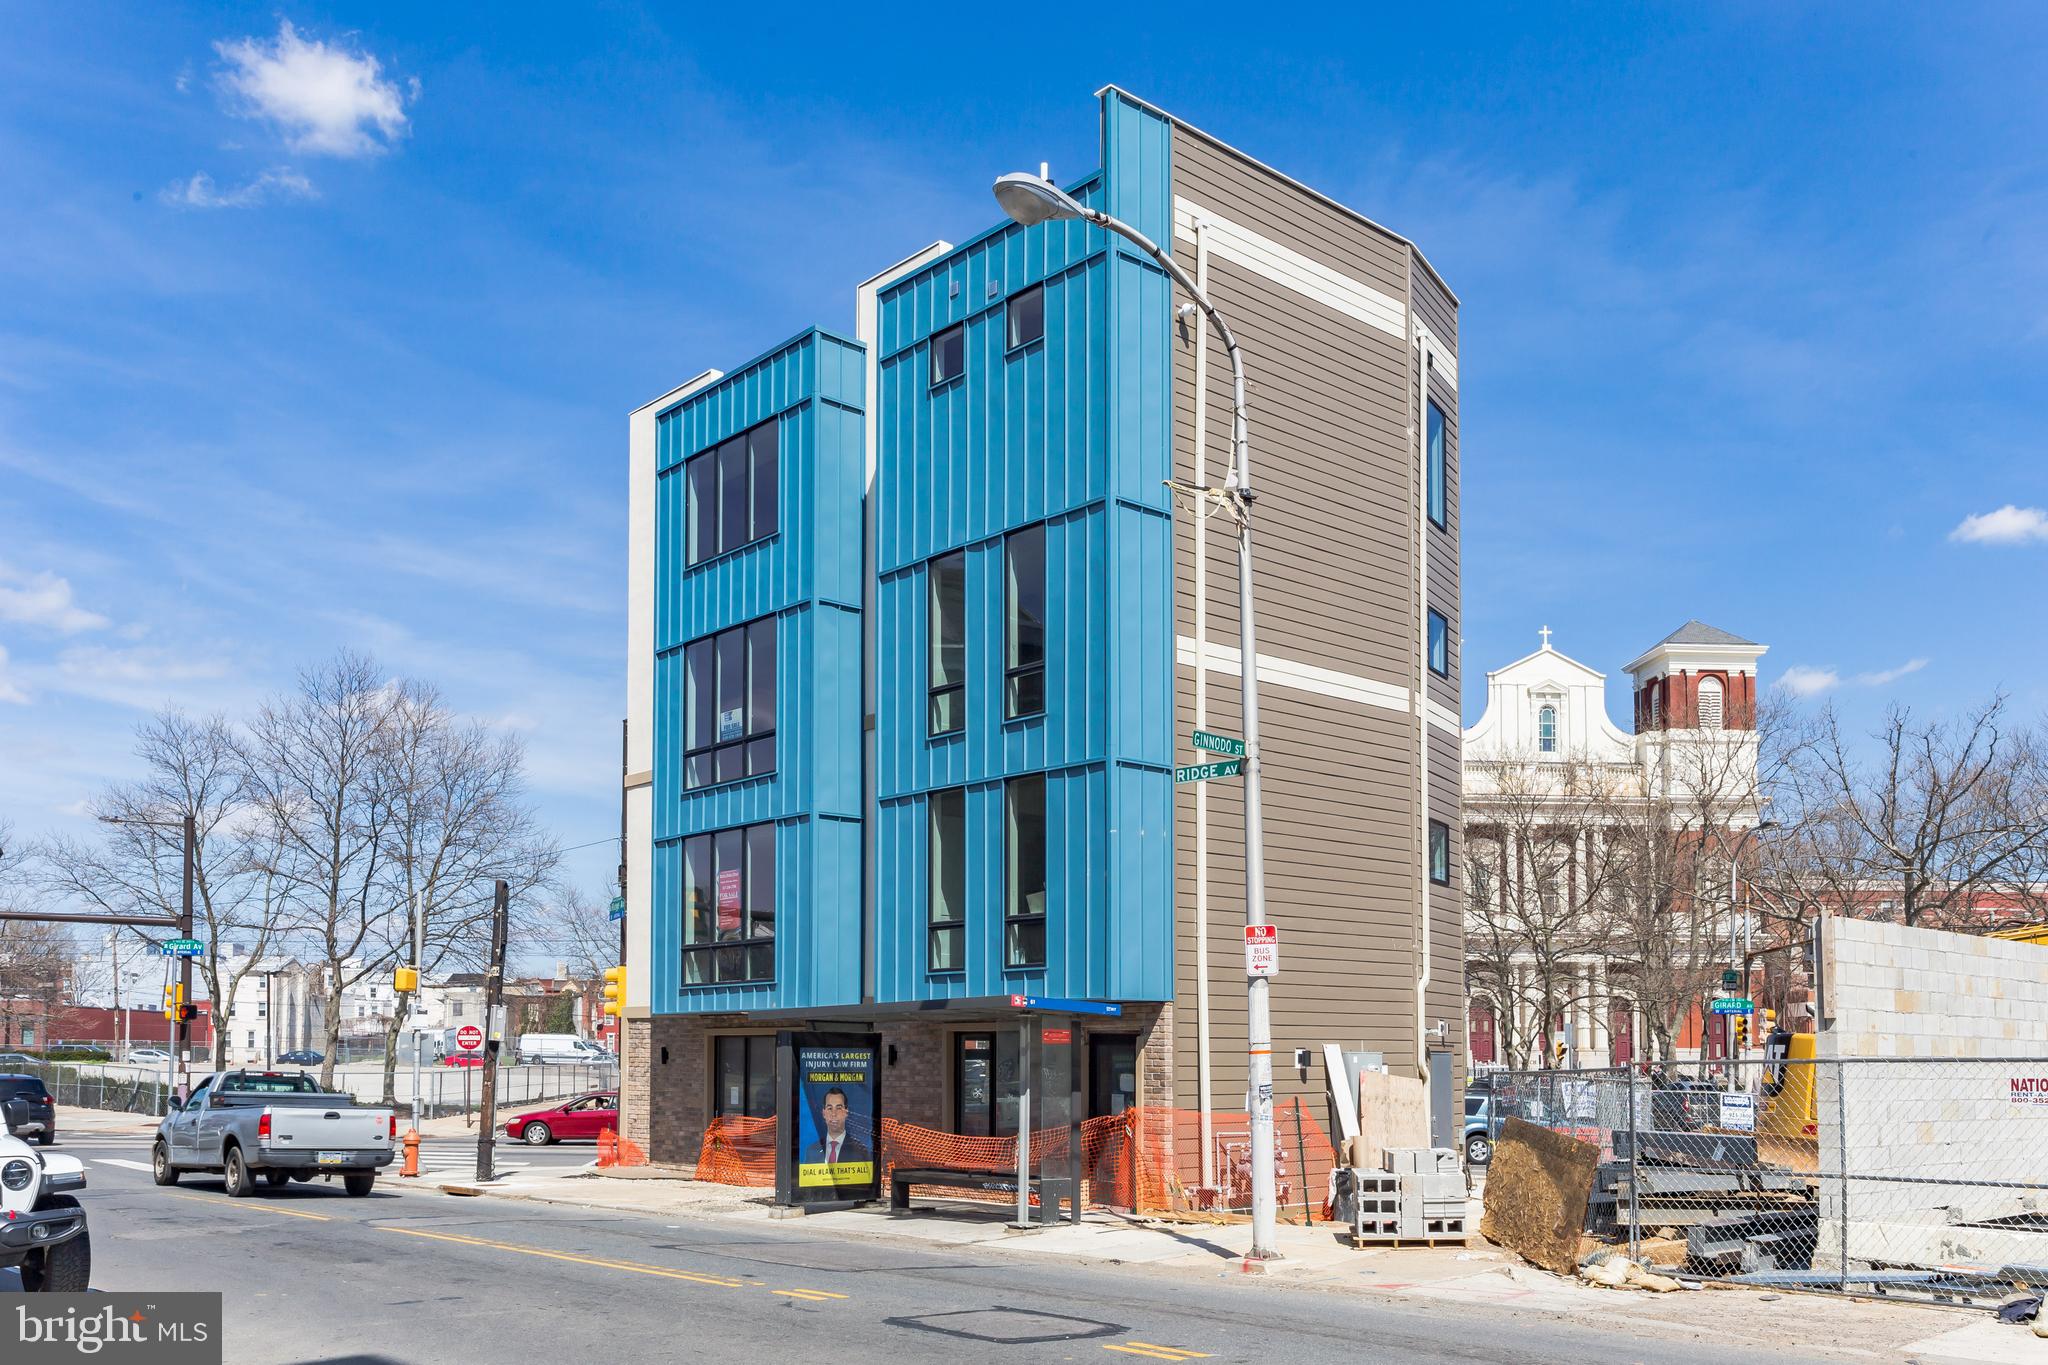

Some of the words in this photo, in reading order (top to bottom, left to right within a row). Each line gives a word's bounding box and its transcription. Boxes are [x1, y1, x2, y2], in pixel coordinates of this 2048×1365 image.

[1194, 733, 1231, 752] GINNODO
[1235, 744, 1243, 754] ST
[1177, 765, 1218, 782] RIDGE
[1224, 764, 1238, 775] AV
[1255, 927, 1266, 937] NO
[1247, 936, 1275, 944] STOPPING
[805, 1061, 831, 1069] INJURY
[809, 1073, 834, 1081] MORGAN
[834, 1073, 839, 1081] &
[839, 1073, 864, 1081] MORGAN
[2010, 1078, 2048, 1092] NATIO
[802, 1168, 816, 1176] DIAL
[837, 1166, 855, 1174] THAT'S
